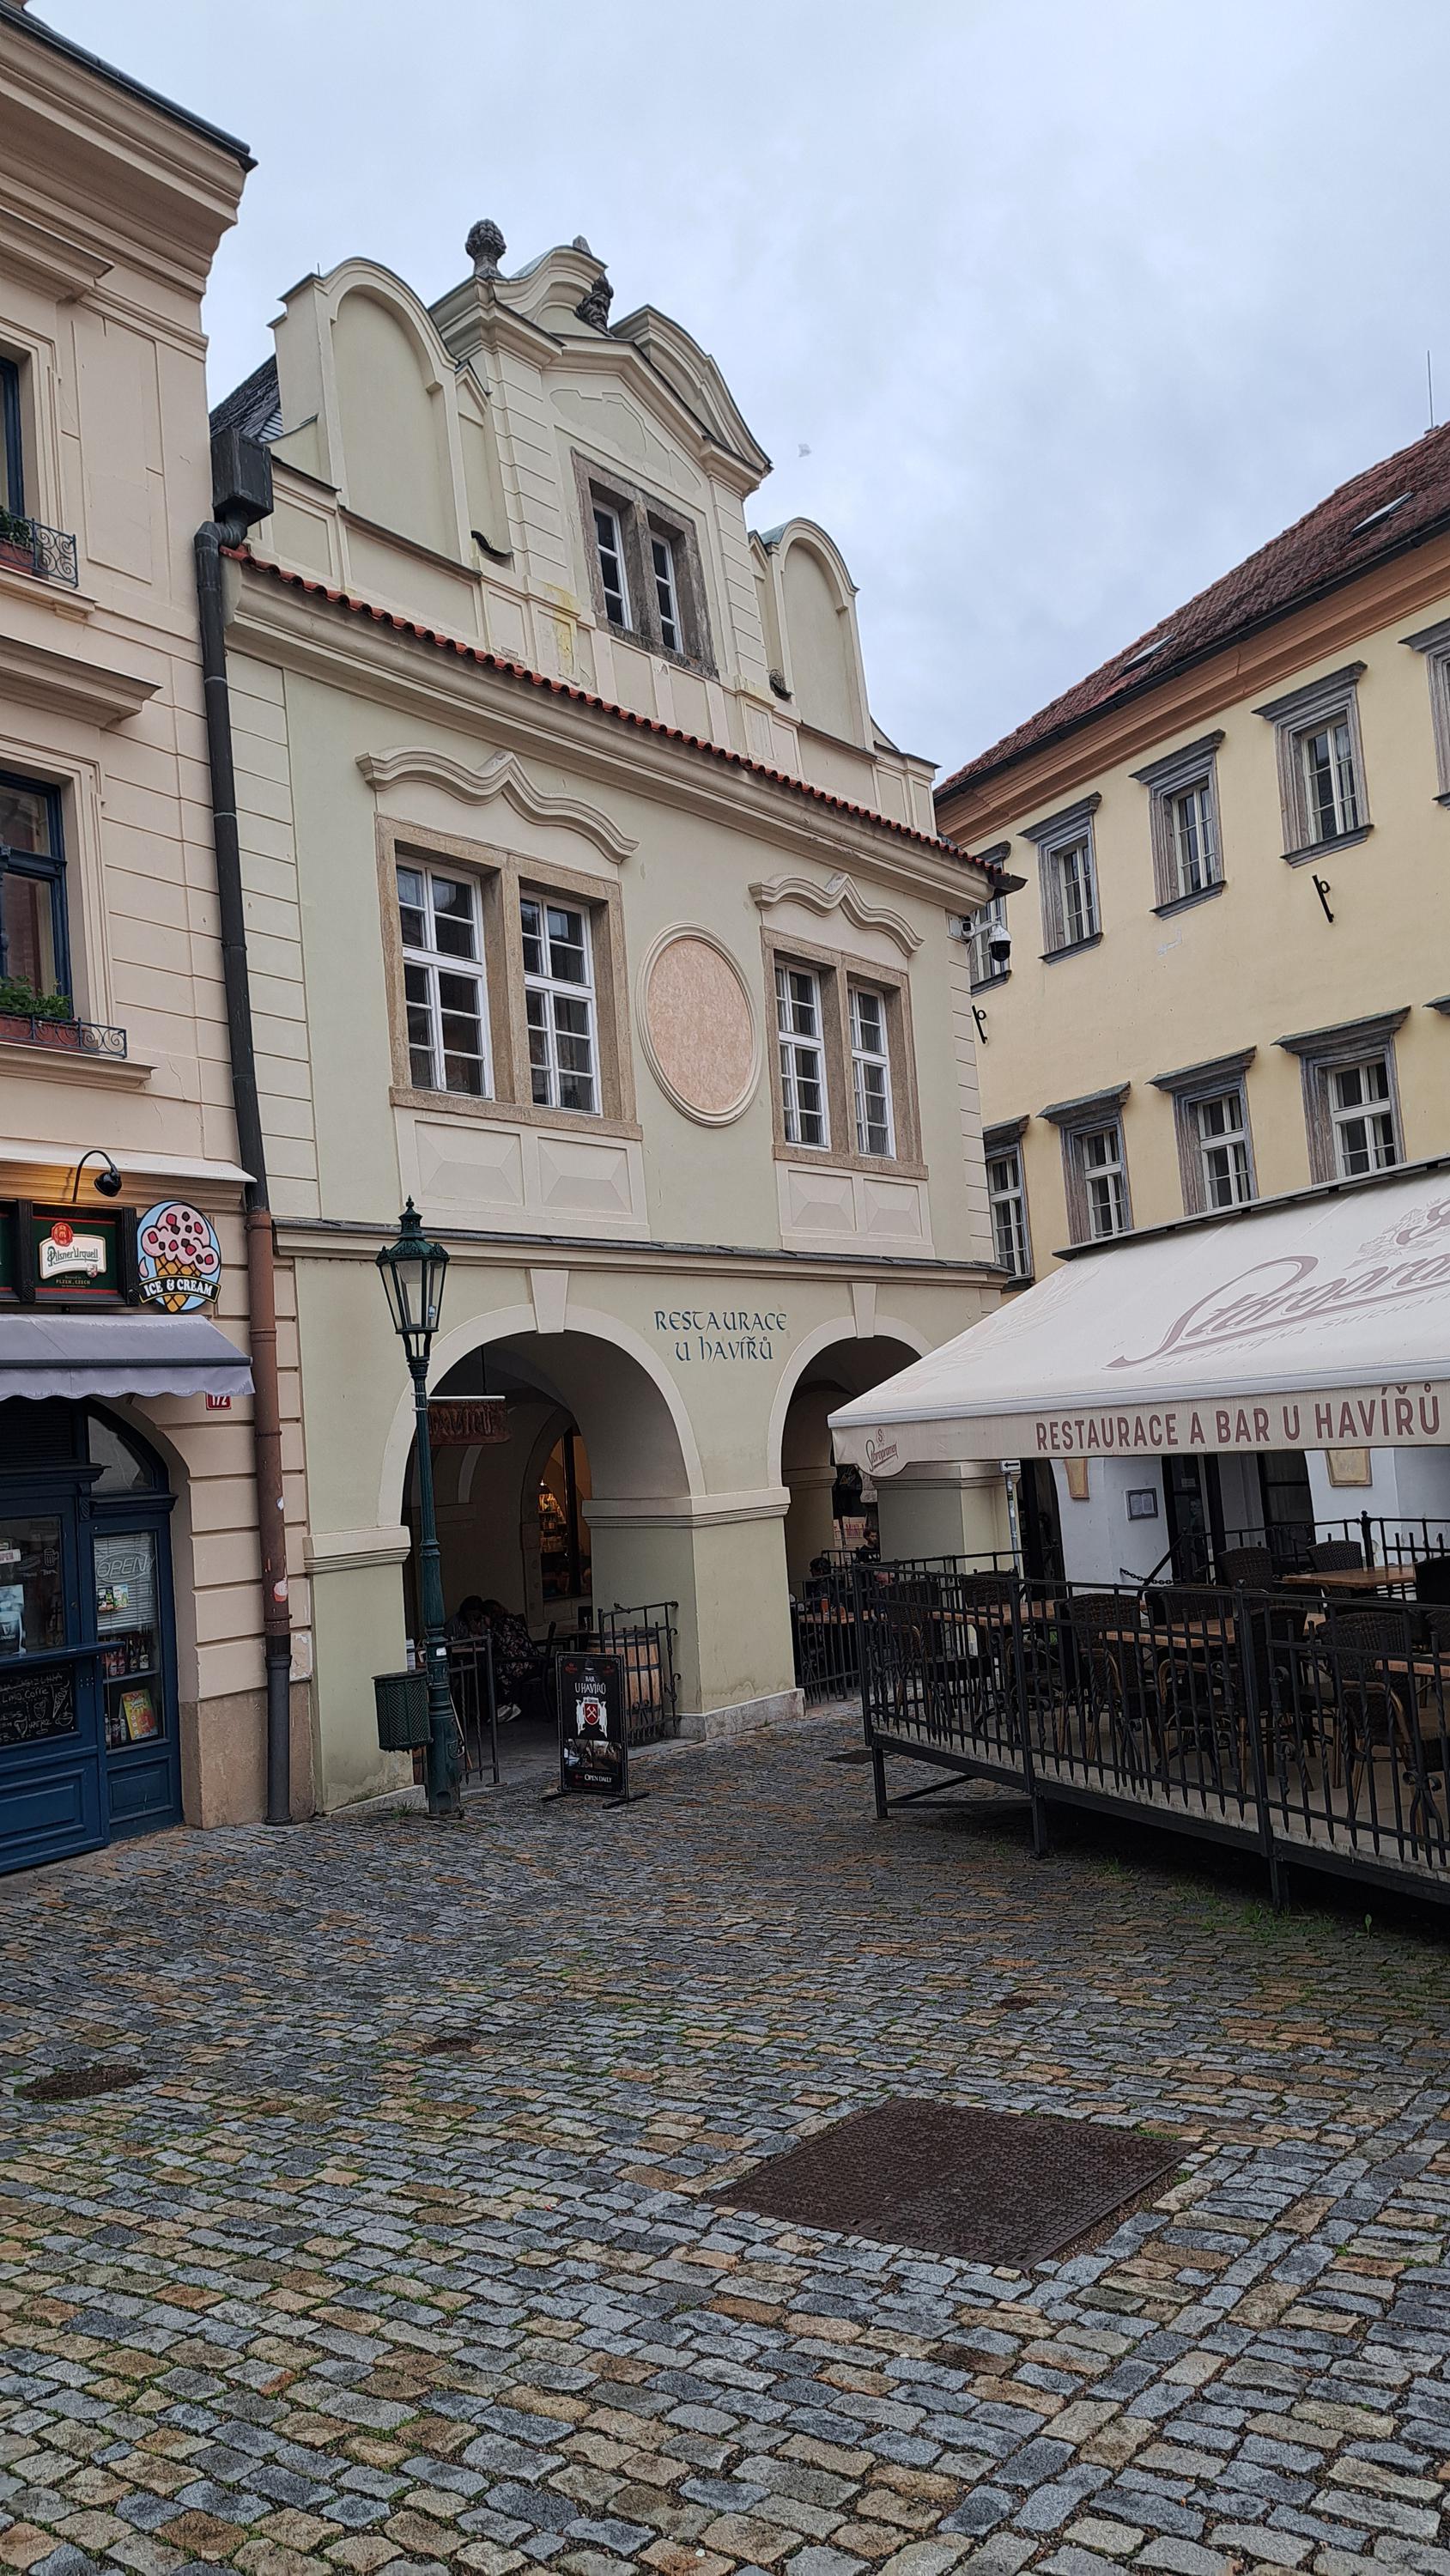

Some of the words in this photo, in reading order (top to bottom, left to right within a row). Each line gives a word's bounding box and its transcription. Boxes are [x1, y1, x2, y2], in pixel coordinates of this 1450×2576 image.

[47, 1246, 74, 1267] Pilsner
[73, 1245, 99, 1262] Urquell
[143, 1281, 163, 1297] ICE
[167, 1279, 175, 1291] &
[177, 1279, 214, 1297] CREAM
[653, 1310, 787, 1333] RESTAURACE
[675, 1341, 691, 1362] U
[1035, 1413, 1179, 1450] RESTAURACE
[1189, 1412, 1206, 1444] A
[1216, 1406, 1270, 1443] BAR
[1283, 1405, 1301, 1441] U
[1314, 1382, 1441, 1439] HAVÍŘŮ
[97, 1554, 148, 1579] OPEN
[574, 1682, 580, 1693] U
